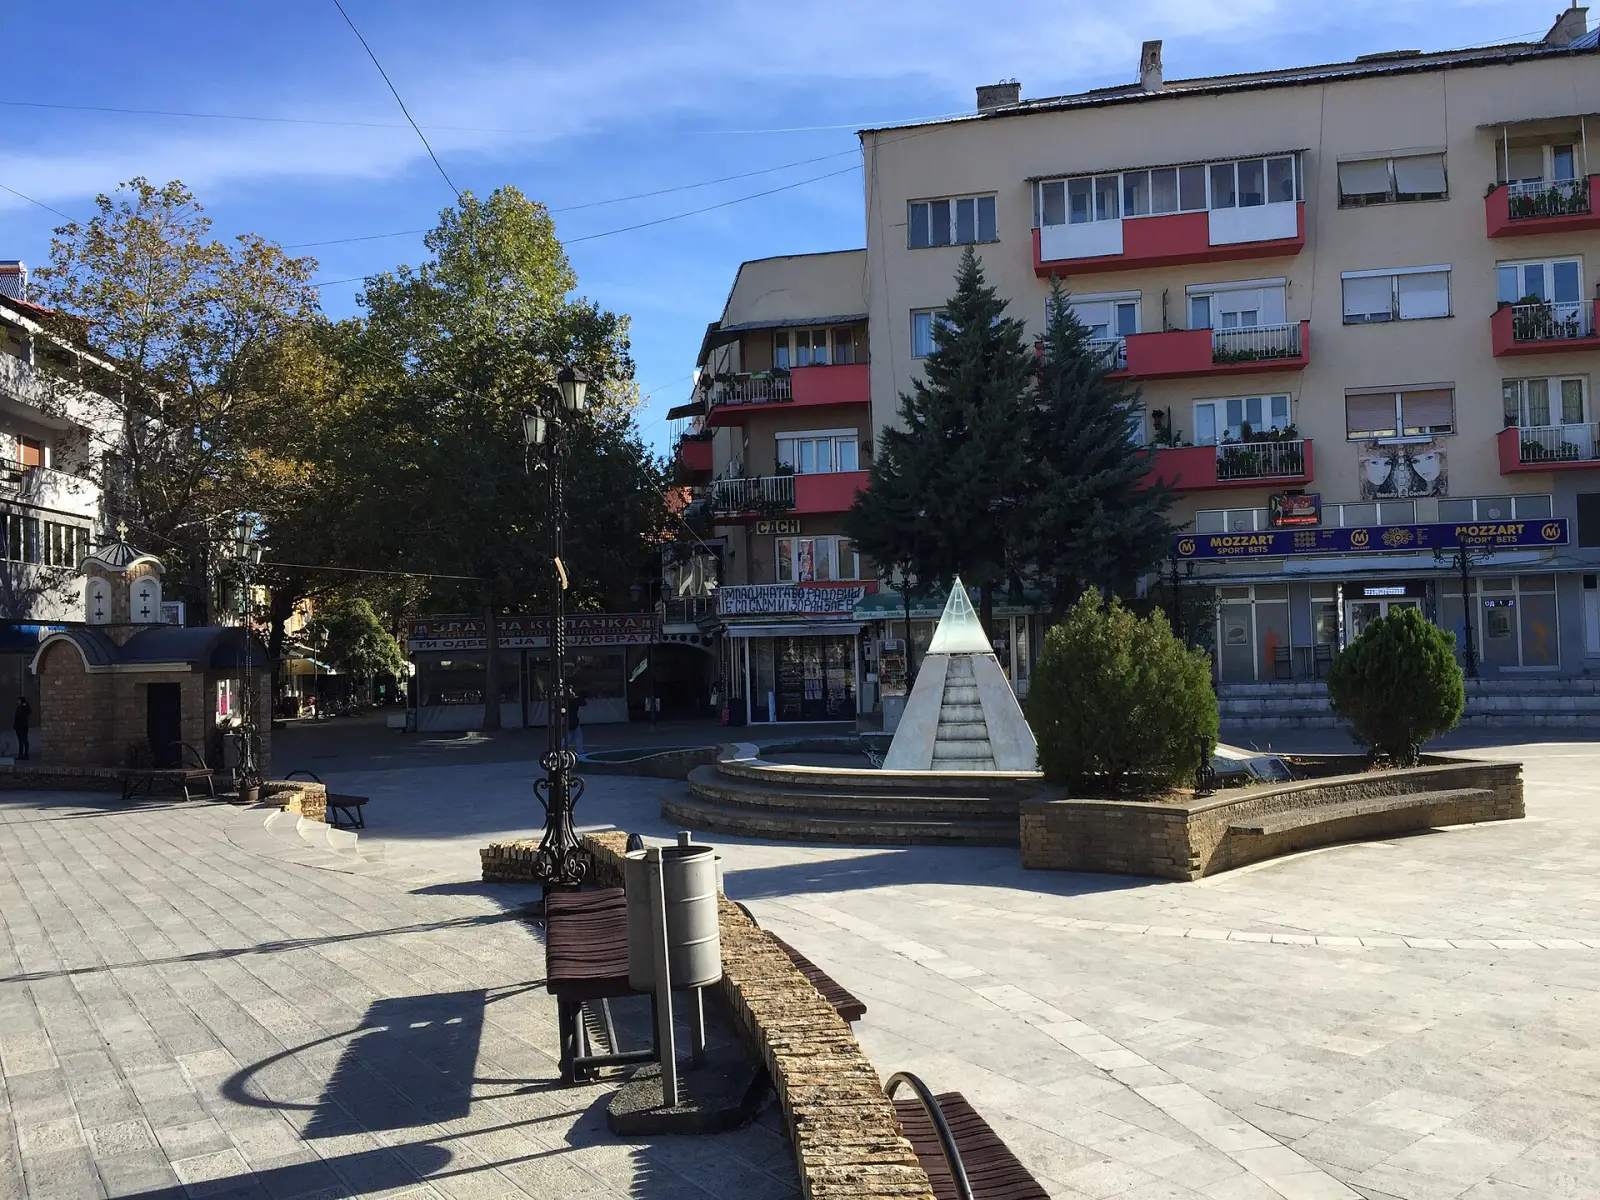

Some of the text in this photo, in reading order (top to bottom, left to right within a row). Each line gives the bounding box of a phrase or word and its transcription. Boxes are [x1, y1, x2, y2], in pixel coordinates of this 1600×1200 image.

[757, 520, 798, 534] СДСМ
[1455, 524, 1525, 536] MOZZART
[1210, 535, 1275, 547] MOZZART
[1496, 535, 1518, 543] BETS
[1217, 545, 1268, 555] SPORT BETS
[442, 638, 510, 649] ОДБЕИ
